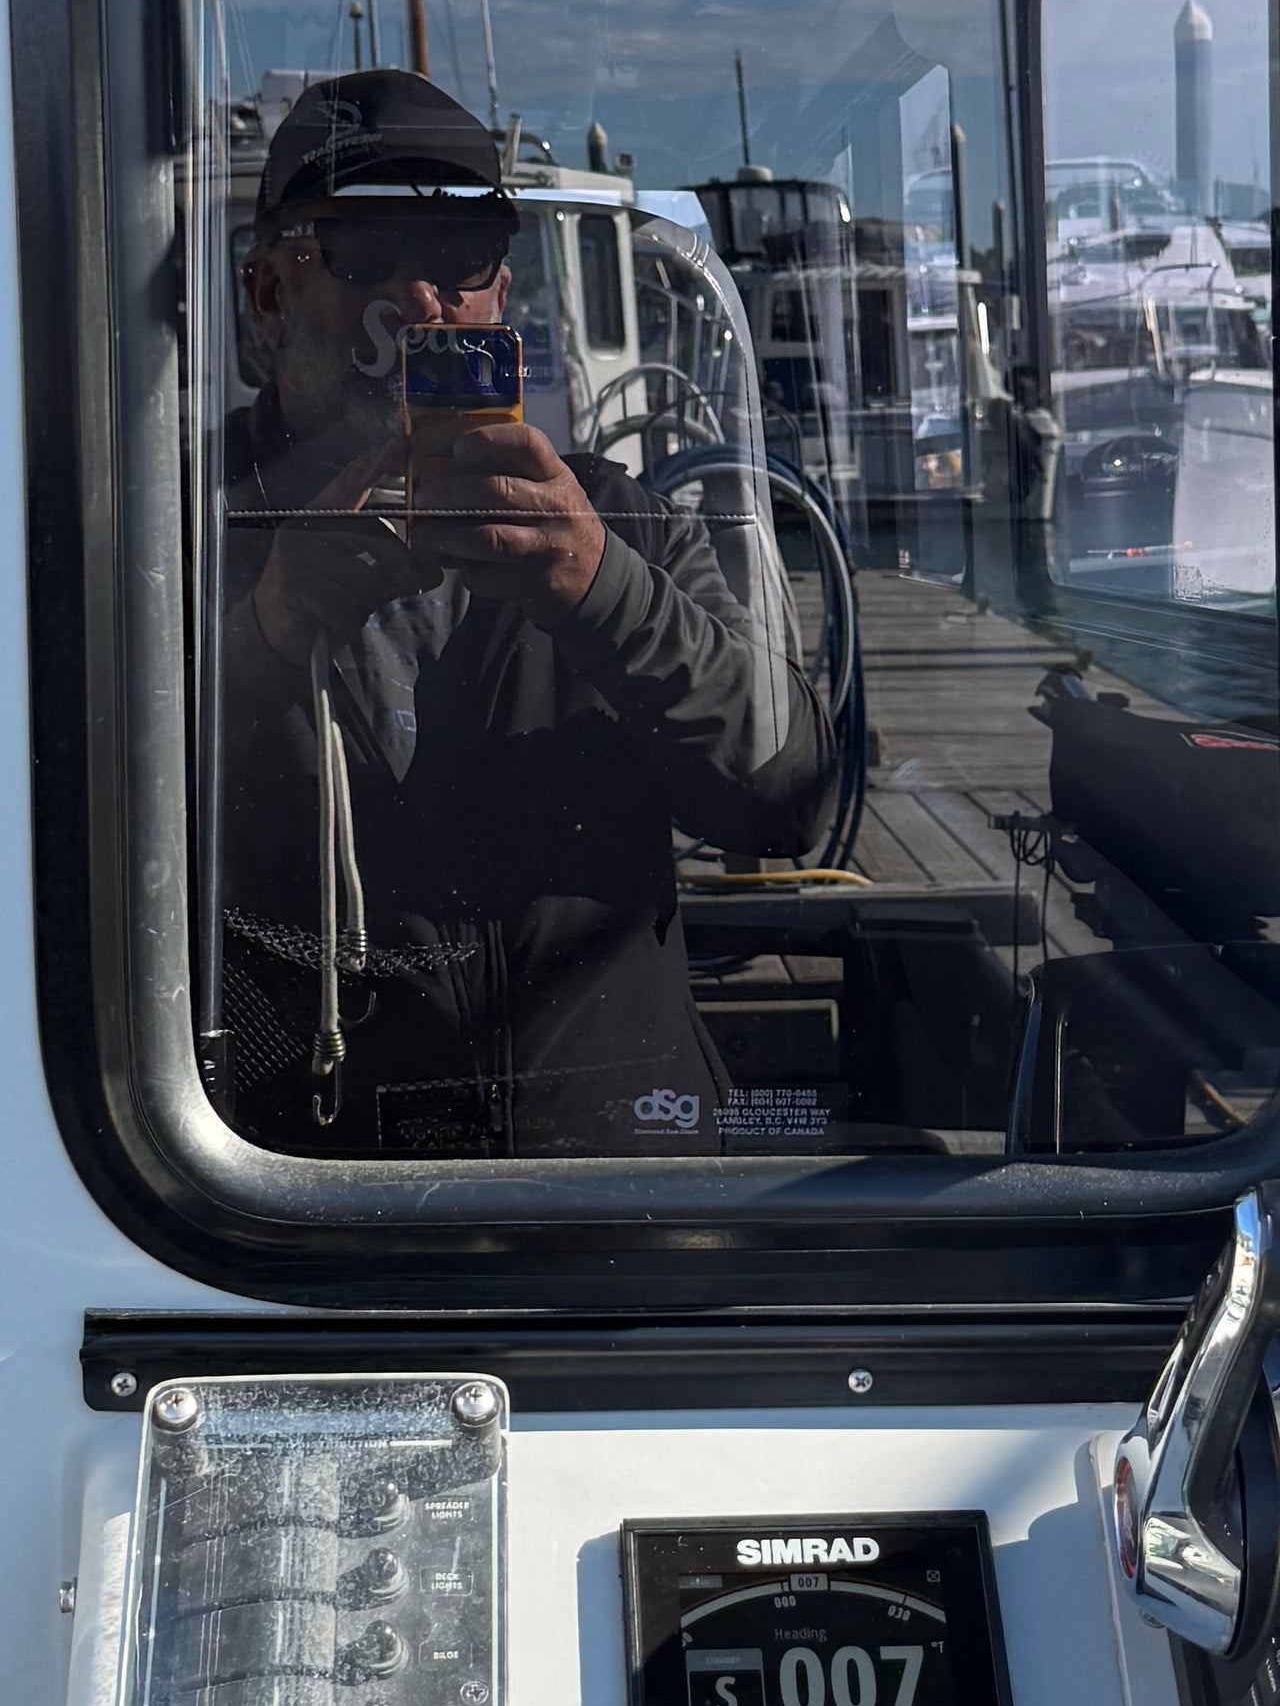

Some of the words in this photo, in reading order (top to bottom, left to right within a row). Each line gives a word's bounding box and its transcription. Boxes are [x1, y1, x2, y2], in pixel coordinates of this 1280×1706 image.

[634, 1089, 700, 1128] dsg
[718, 1127, 765, 1135] PRODUCT
[784, 1127, 825, 1135] CANADA
[424, 1501, 470, 1510] SPREADER
[431, 1510, 462, 1519] LIGHTS
[736, 1537, 880, 1565] SIMRAD
[431, 1581, 463, 1590] LIGHTS
[797, 1576, 820, 1588] 007
[773, 1595, 797, 1609] 000
[887, 1605, 911, 1621] 030
[773, 1627, 827, 1642] Heading
[432, 1651, 459, 1660] BILGE
